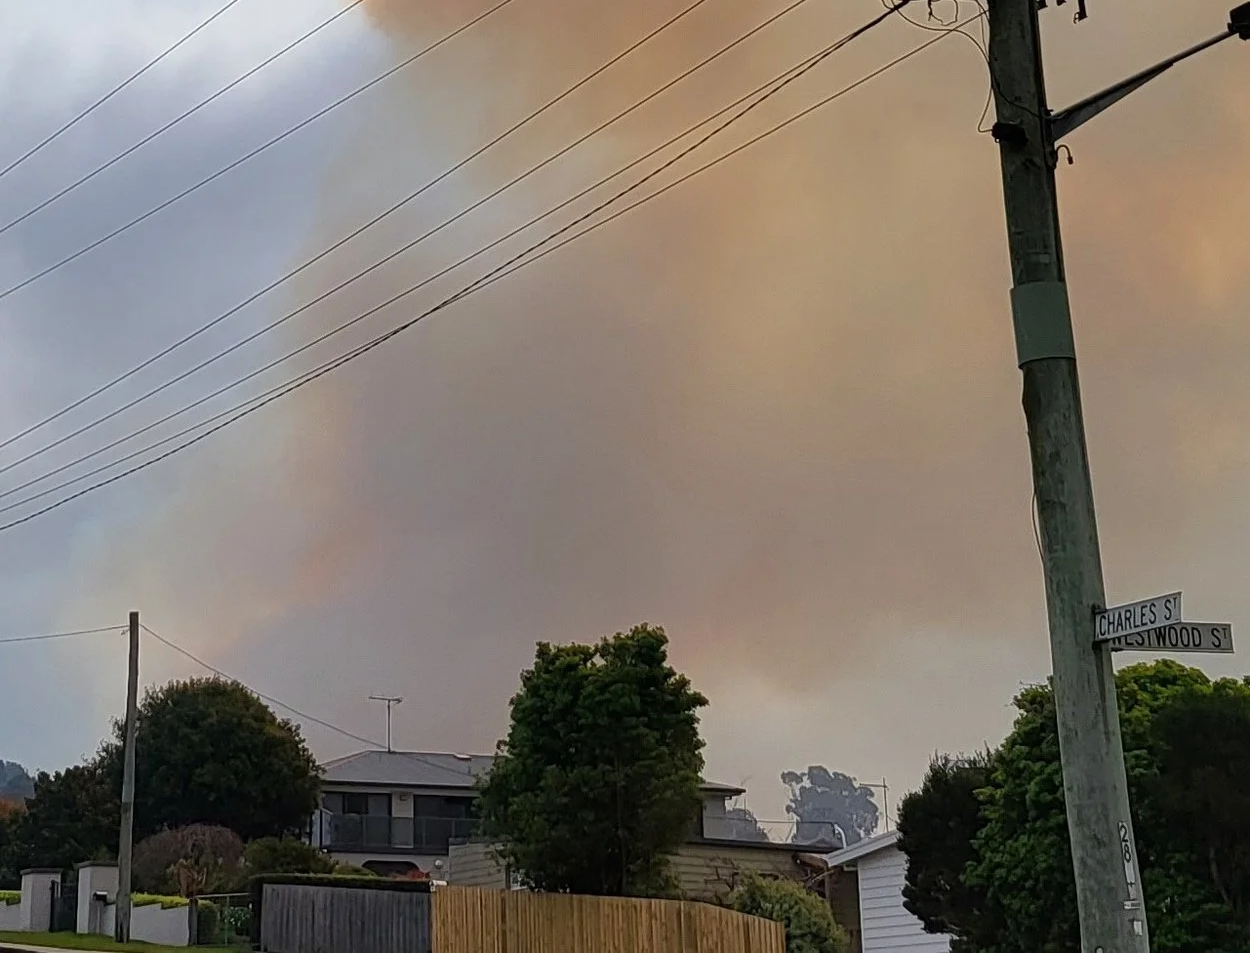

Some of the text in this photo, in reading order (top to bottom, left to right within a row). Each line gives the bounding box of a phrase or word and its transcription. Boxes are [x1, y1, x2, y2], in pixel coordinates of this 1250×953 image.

[1099, 596, 1178, 637] CHARLES ST
[1210, 627, 1228, 648] ST
[1119, 824, 1132, 863] 28
